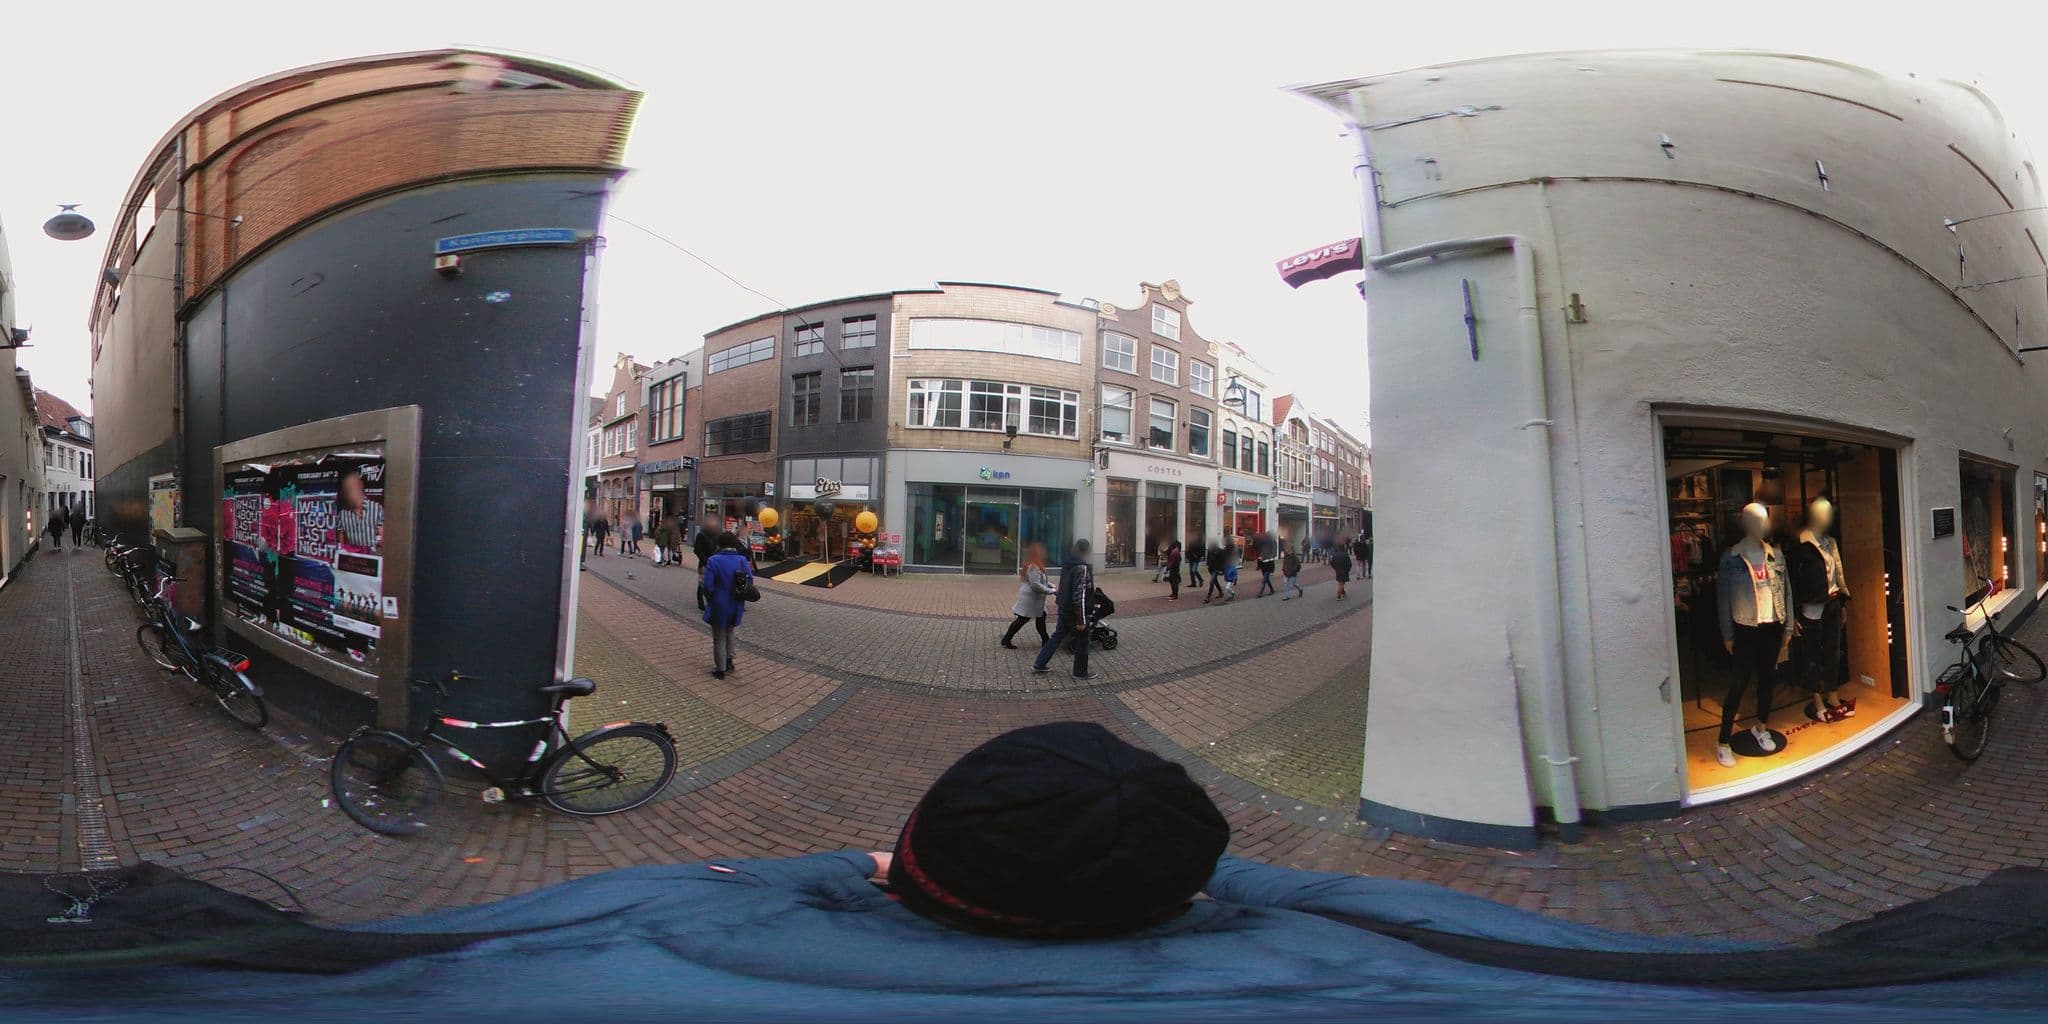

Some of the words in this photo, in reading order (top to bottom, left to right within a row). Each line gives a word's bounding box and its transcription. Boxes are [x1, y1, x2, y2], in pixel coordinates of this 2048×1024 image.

[447, 232, 562, 247] Koningsplein
[993, 470, 1010, 480] kpn
[1147, 465, 1181, 477] COSTES
[815, 477, 842, 496] Etos
[236, 499, 257, 510] WHAT
[299, 501, 334, 514] WHAT
[236, 510, 263, 522] ABOUT
[299, 512, 336, 529] ABOU
[235, 531, 259, 543] NIGHT
[298, 527, 328, 543] LAST
[298, 541, 336, 559] NIGHT
